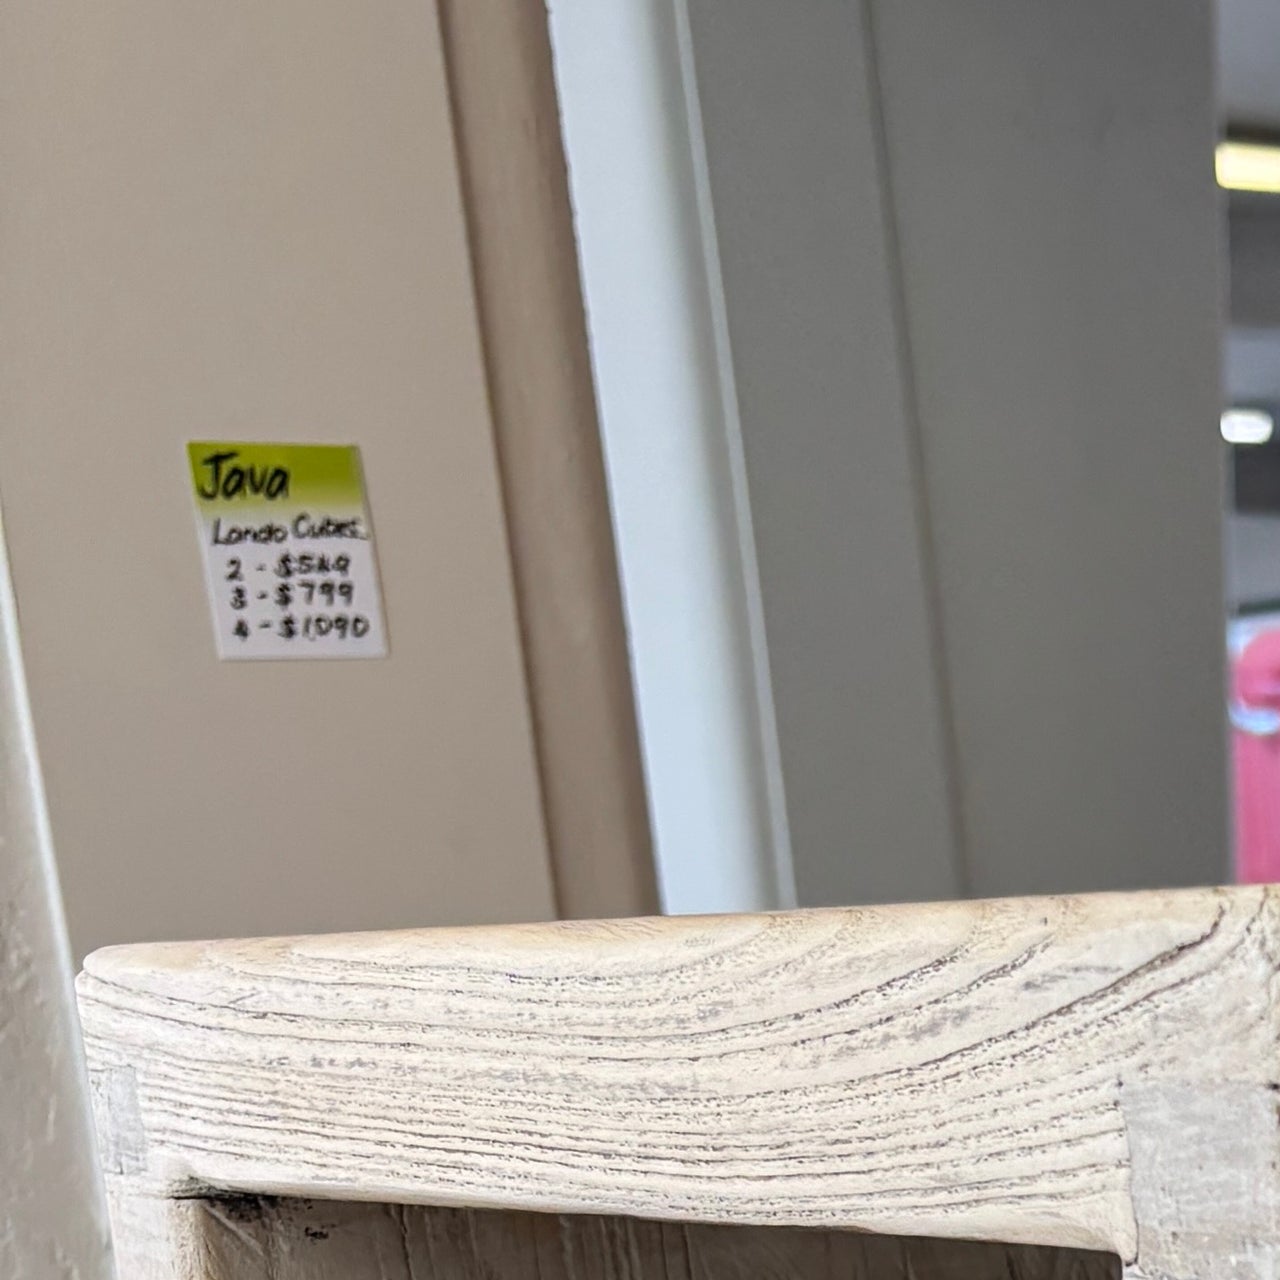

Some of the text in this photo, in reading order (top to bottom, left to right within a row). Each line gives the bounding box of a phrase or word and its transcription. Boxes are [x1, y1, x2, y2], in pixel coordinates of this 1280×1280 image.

[198, 450, 290, 500] Java
[226, 557, 243, 582] 2
[231, 586, 248, 611] 3
[274, 581, 354, 610] $799
[278, 614, 370, 642] $1090
